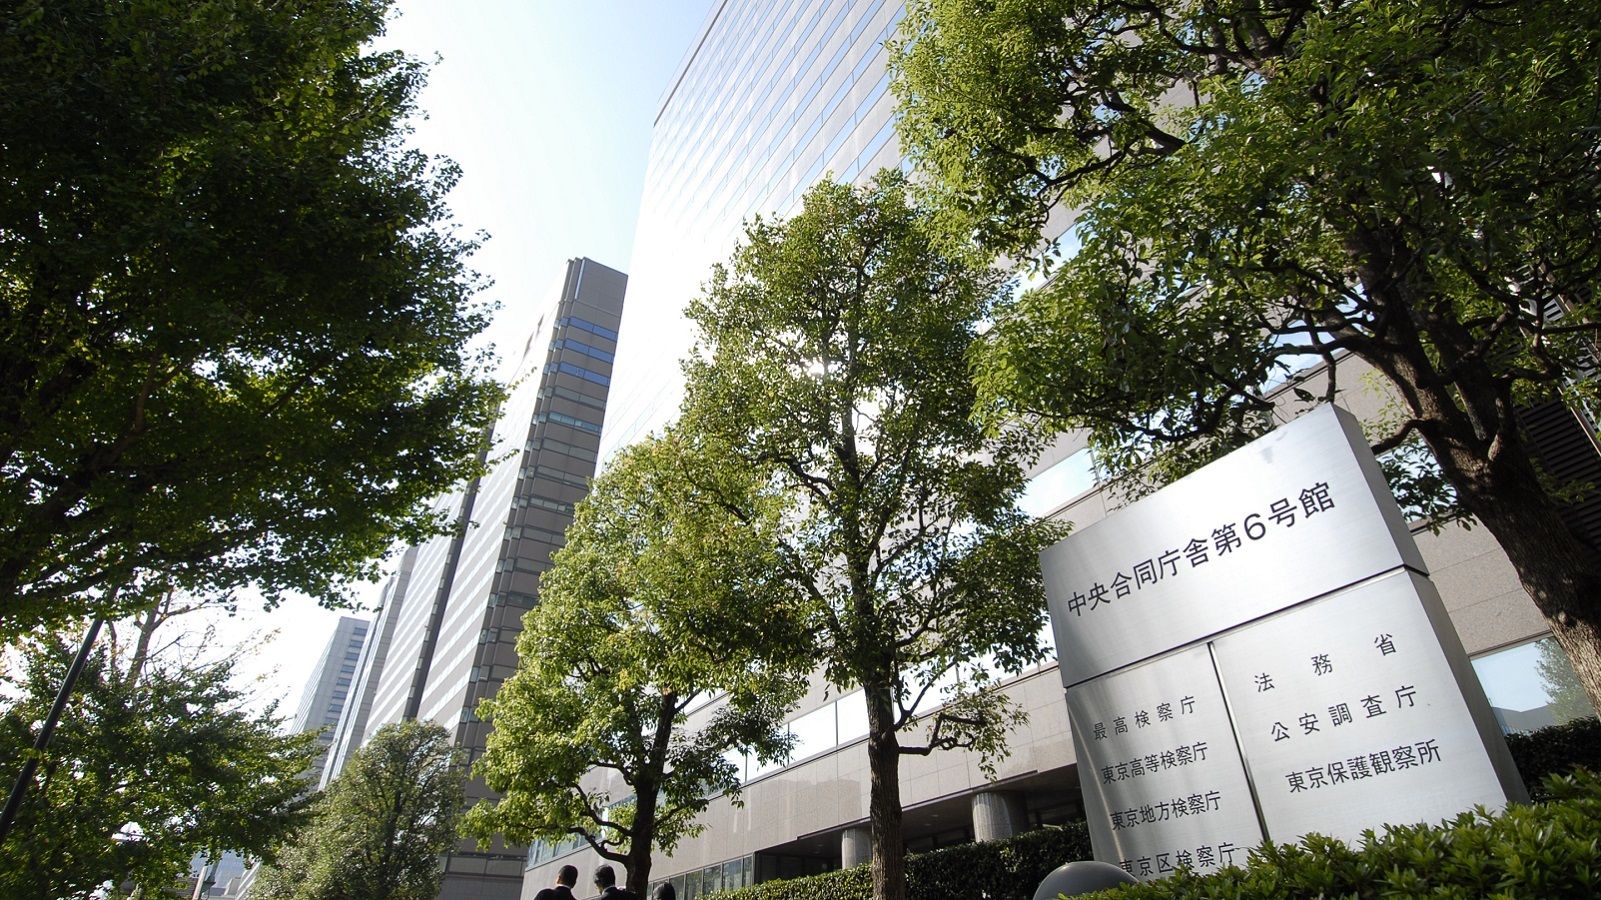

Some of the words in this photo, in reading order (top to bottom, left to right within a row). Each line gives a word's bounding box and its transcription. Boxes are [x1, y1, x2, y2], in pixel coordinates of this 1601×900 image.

[1067, 481, 1336, 618] 中央合同庁舎第6号館
[1254, 632, 1396, 693] 法務省
[1093, 695, 1196, 741] 最高検察庁
[1270, 685, 1418, 743] 公安調査庁
[1101, 741, 1208, 784] 東京高等検察庁
[1285, 738, 1442, 794] 東京保護観察所
[1110, 790, 1221, 831] 東京地方検察庁
